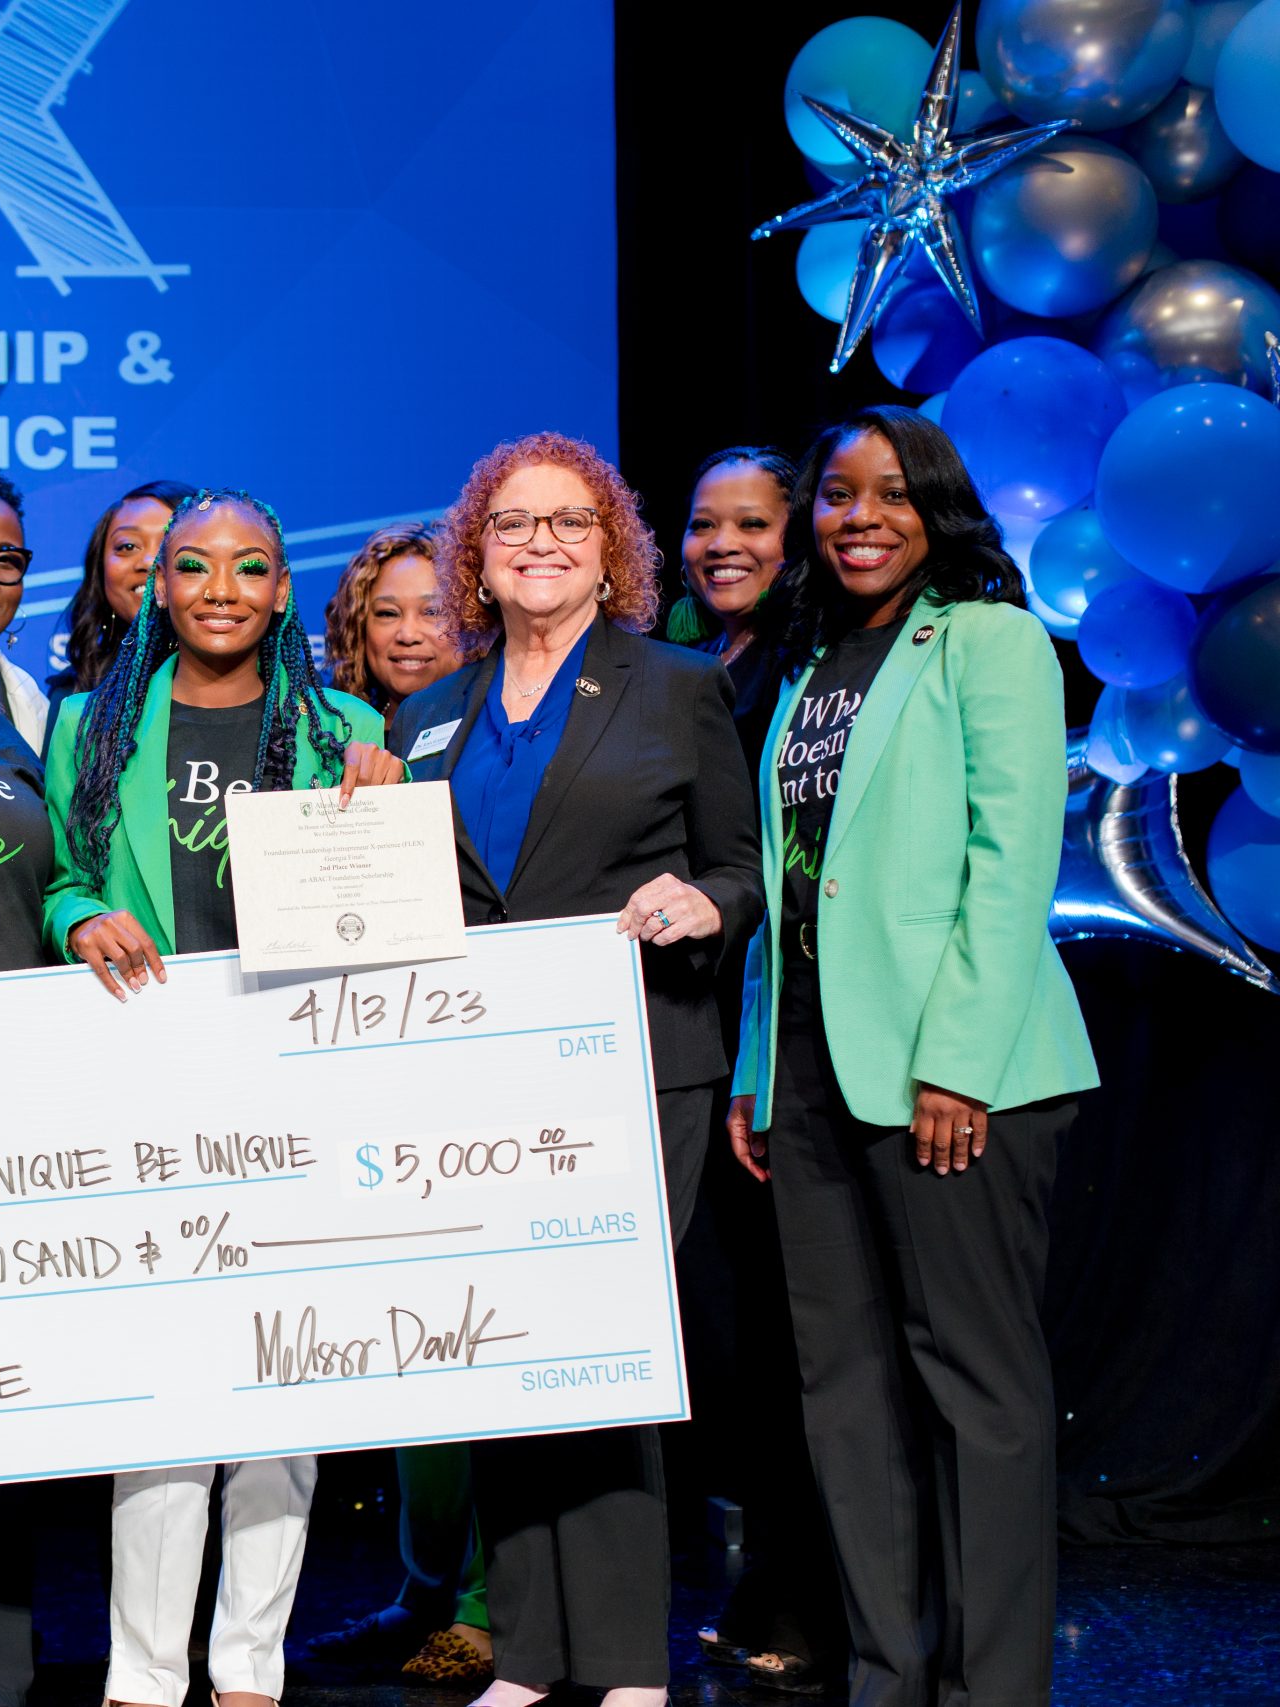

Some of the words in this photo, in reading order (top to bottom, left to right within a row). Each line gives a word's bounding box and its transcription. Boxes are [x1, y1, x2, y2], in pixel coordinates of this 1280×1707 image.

[119, 331, 174, 383] &
[914, 629, 933, 639] VIP
[580, 678, 599, 694] VIP
[402, 839, 425, 849] (FLEX)
[350, 862, 372, 870] Winner
[308, 876, 327, 884] ABAC
[289, 972, 487, 1045] 4/13/23
[558, 1034, 617, 1058] DATE
[134, 1141, 182, 1183] BE
[195, 1132, 317, 1179] UNIQUE
[530, 1212, 637, 1241] DOLLARS
[521, 1361, 653, 1391] SIGNATURE
